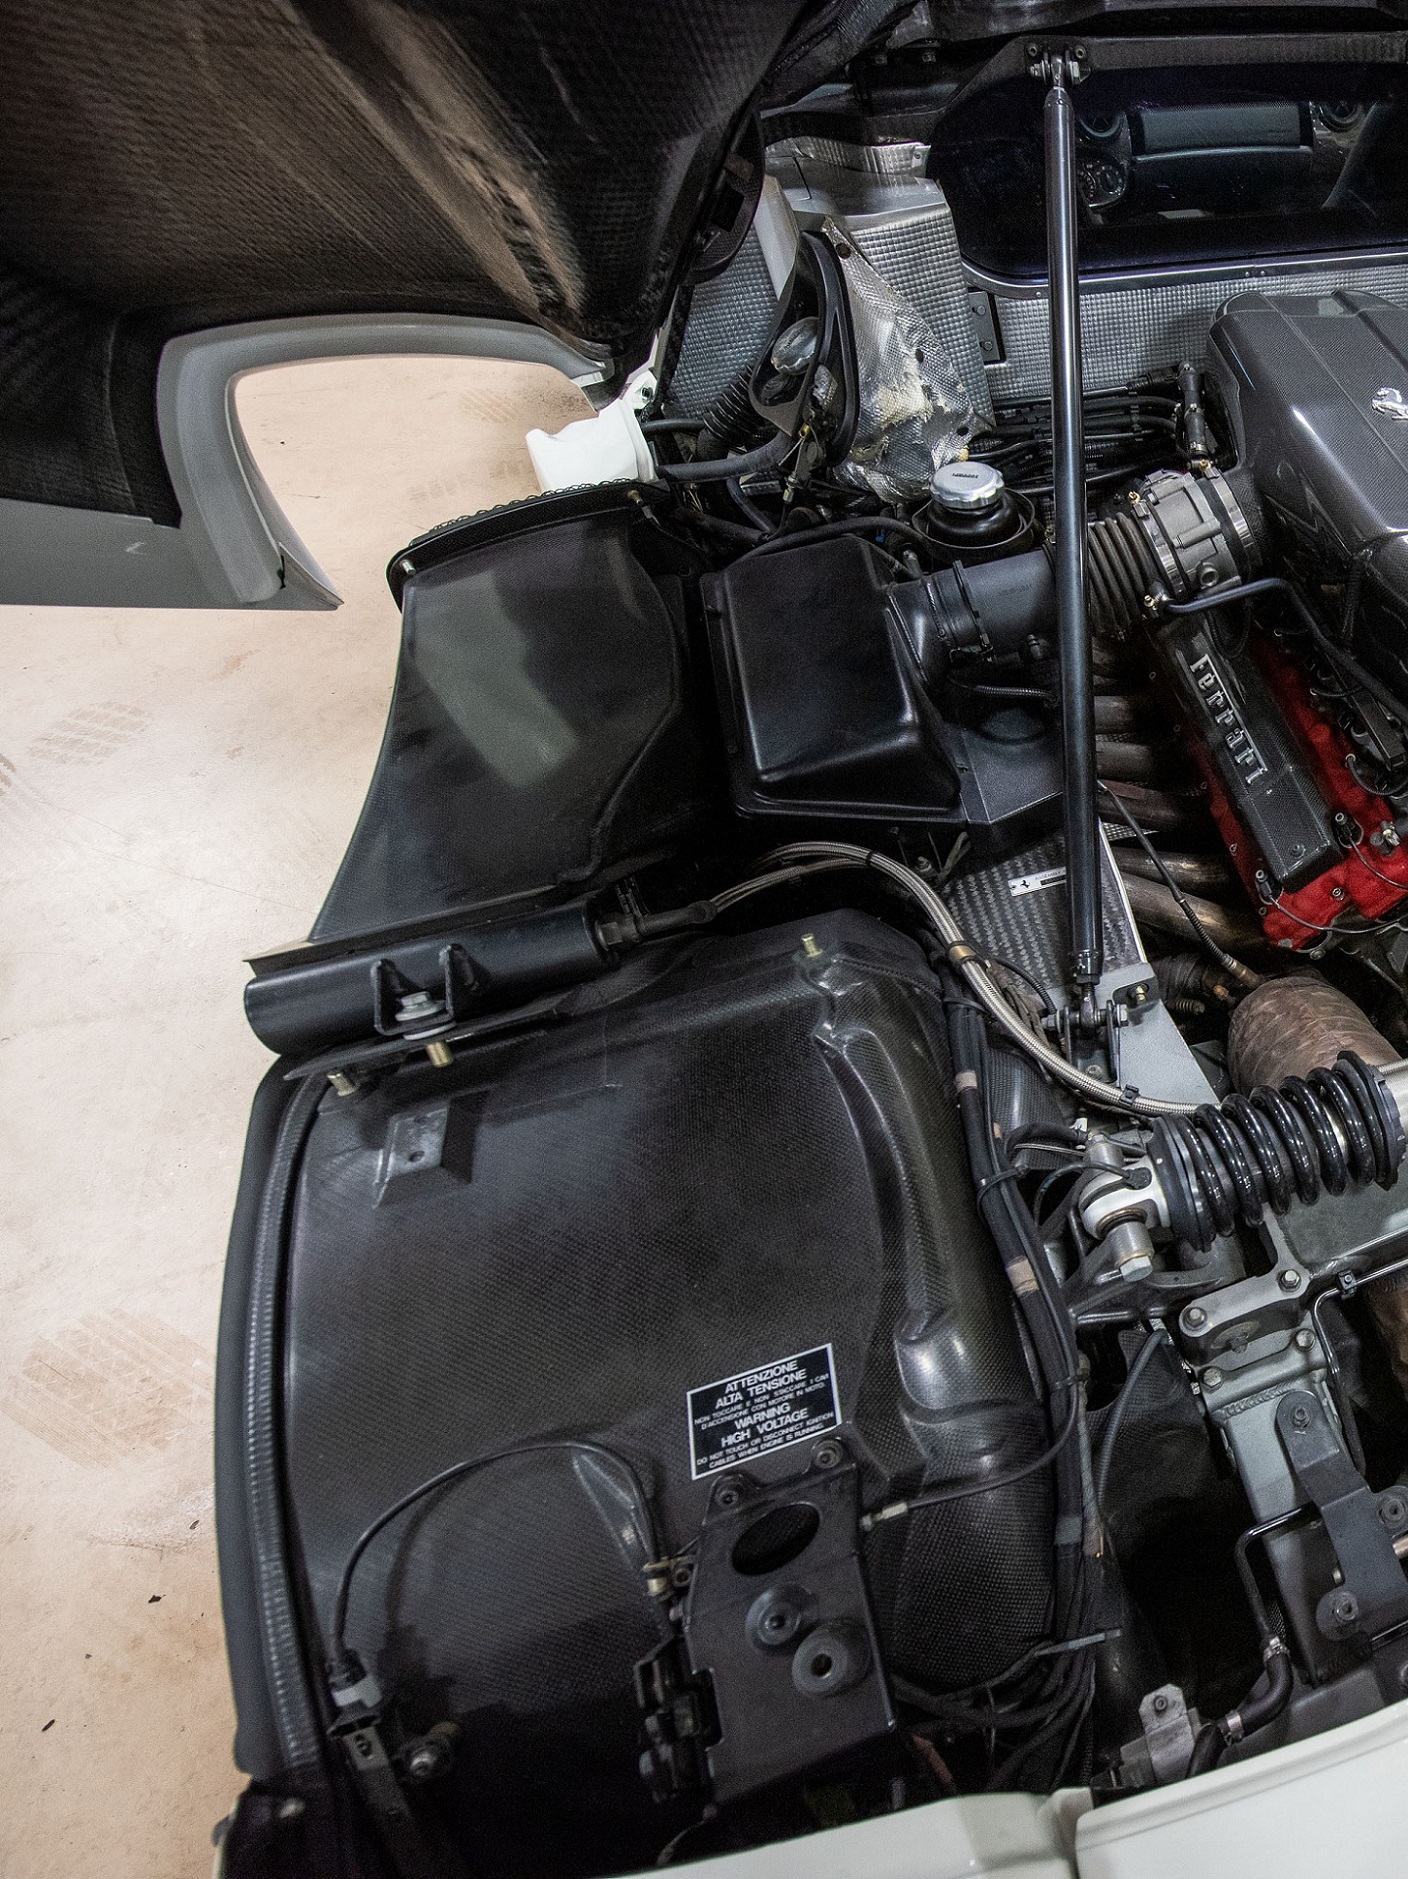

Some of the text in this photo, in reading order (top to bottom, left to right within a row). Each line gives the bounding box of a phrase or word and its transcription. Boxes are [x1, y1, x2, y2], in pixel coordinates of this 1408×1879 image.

[1189, 654, 1268, 785] Ferrari
[715, 1368, 808, 1410] ALTA TENSIONE
[725, 1360, 798, 1394] ATTENZIONE
[694, 1415, 710, 1425] NON
[711, 1402, 743, 1418] TOCCARE
[754, 1394, 770, 1404] NON
[734, 1402, 790, 1430] WARNING
[750, 1402, 768, 1412] CON
[768, 1391, 796, 1406] MOTORE
[796, 1389, 804, 1397] IN
[696, 1411, 834, 1466] DO NOT TOUCH OR DISCONNECT IGNITION
[721, 1407, 809, 1448] HIGH VOLTAGE
[709, 1454, 736, 1469] CABLES
[737, 1445, 759, 1459] WHEN
[760, 1436, 784, 1450] ENGINE
[785, 1434, 794, 1442] IS
